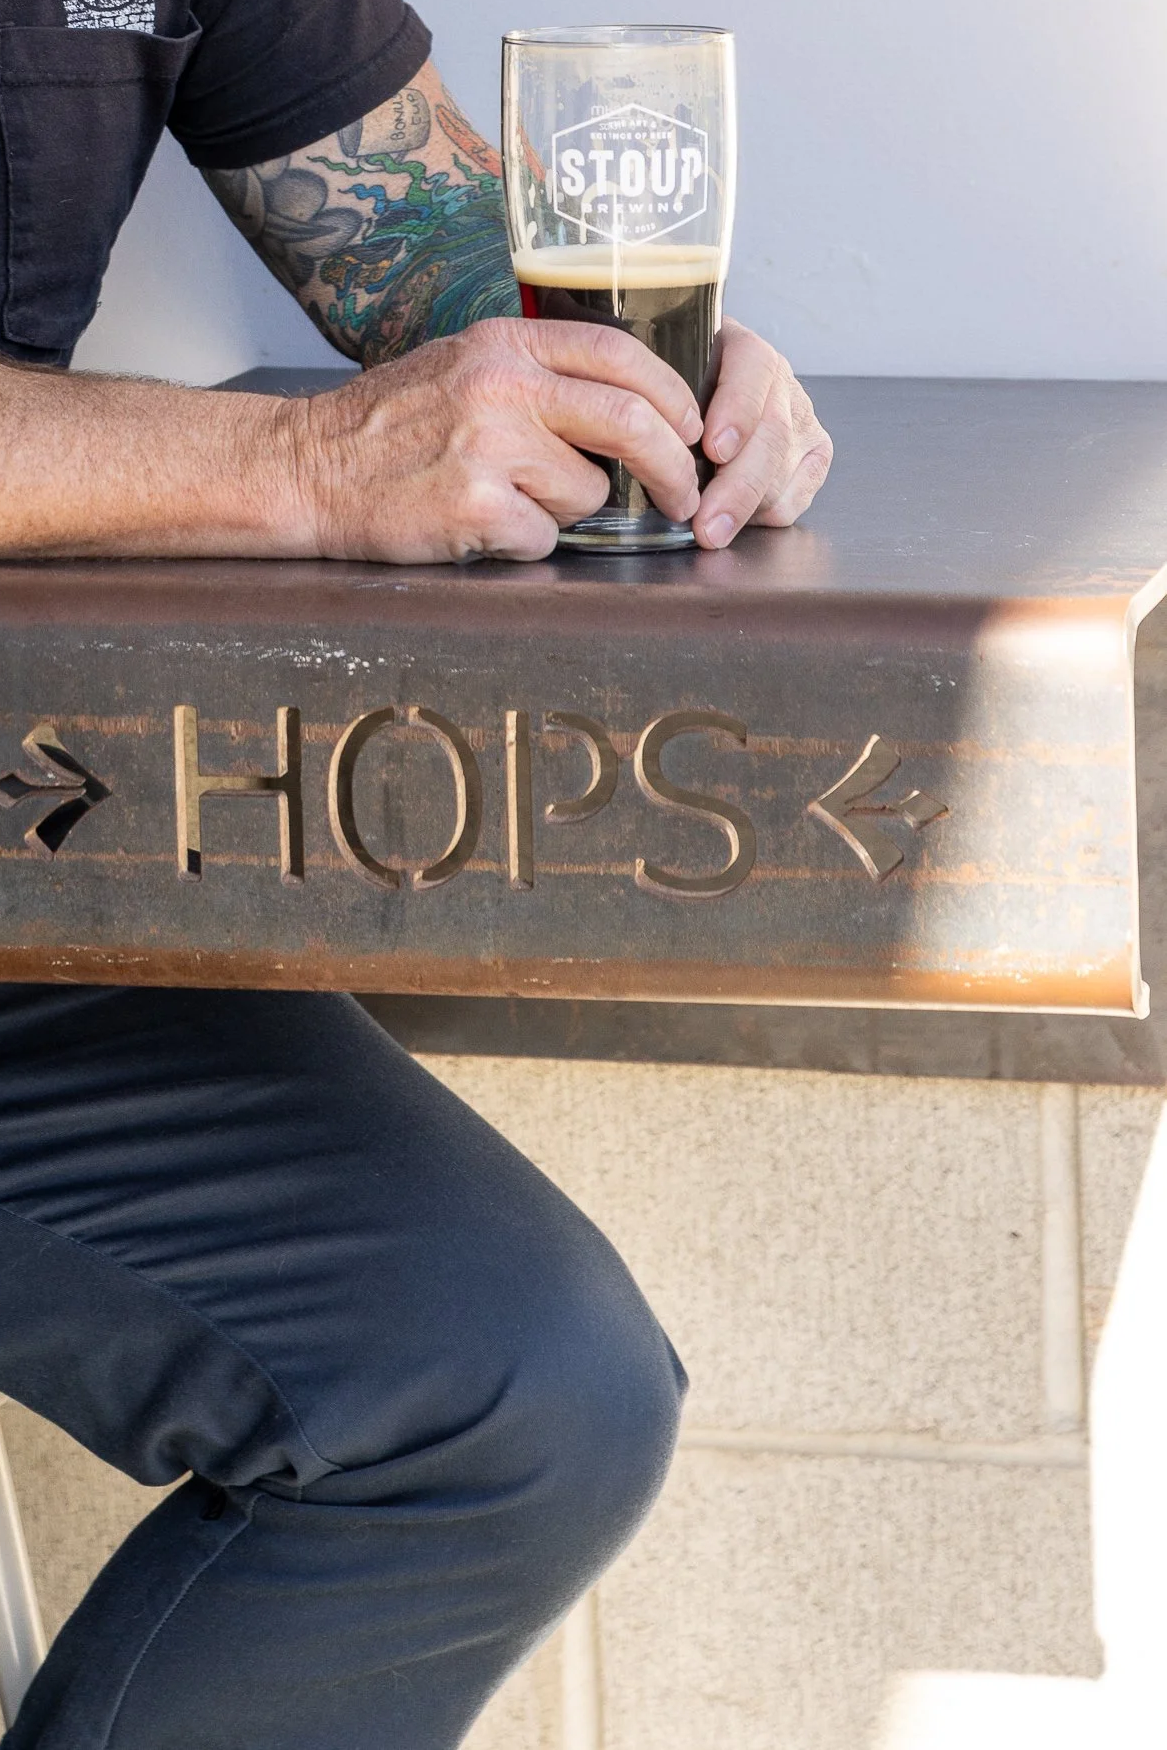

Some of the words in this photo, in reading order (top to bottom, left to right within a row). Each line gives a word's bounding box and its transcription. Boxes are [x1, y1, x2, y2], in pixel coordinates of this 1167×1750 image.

[634, 131, 647, 140] OF
[560, 147, 703, 198] STOUP
[581, 202, 684, 215] BREWING
[173, 703, 757, 900] HOPS
